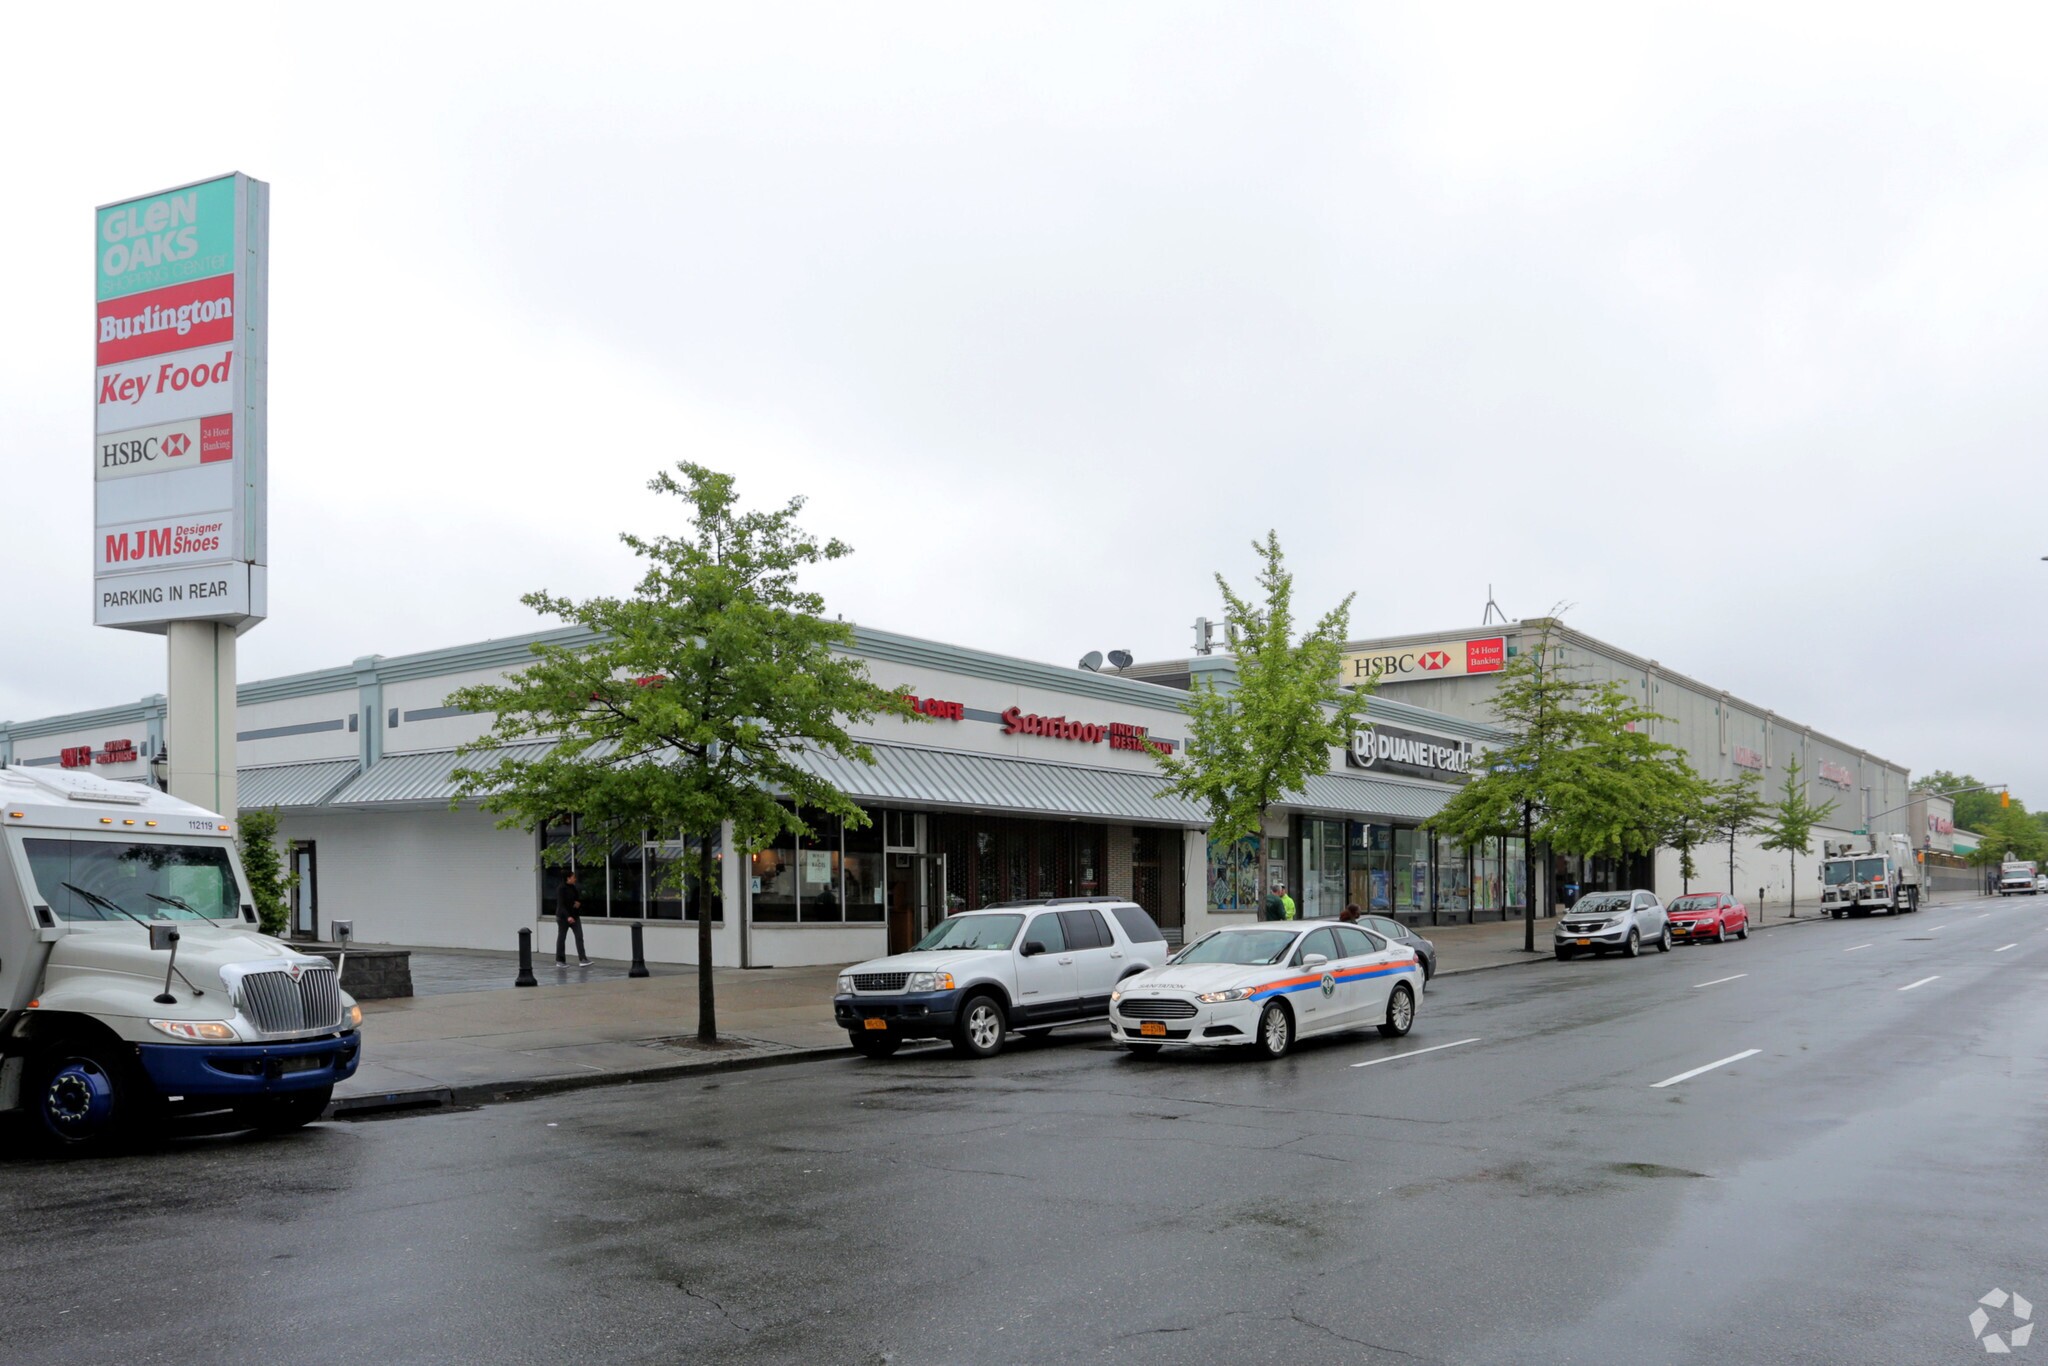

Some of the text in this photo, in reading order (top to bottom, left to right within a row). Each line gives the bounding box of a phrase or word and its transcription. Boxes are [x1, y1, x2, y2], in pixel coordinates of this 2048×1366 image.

[103, 226, 198, 276] OAKS
[99, 296, 232, 343] Burlington
[99, 351, 233, 405] Key Food
[203, 427, 230, 439] 24 Hour
[203, 439, 230, 451] Banking
[102, 437, 159, 468] HSBC
[175, 523, 223, 537] Designer
[106, 527, 172, 563] MJM
[173, 536, 219, 555] Shoes
[103, 581, 228, 608] PARKING IN REAR
[1470, 646, 1500, 656] 24 Hour
[1470, 656, 1501, 667] Banking
[1354, 653, 1415, 678] HSBC
[924, 698, 965, 721] CAFE
[1002, 706, 1108, 744] Santoor
[188, 820, 213, 831] 112119
